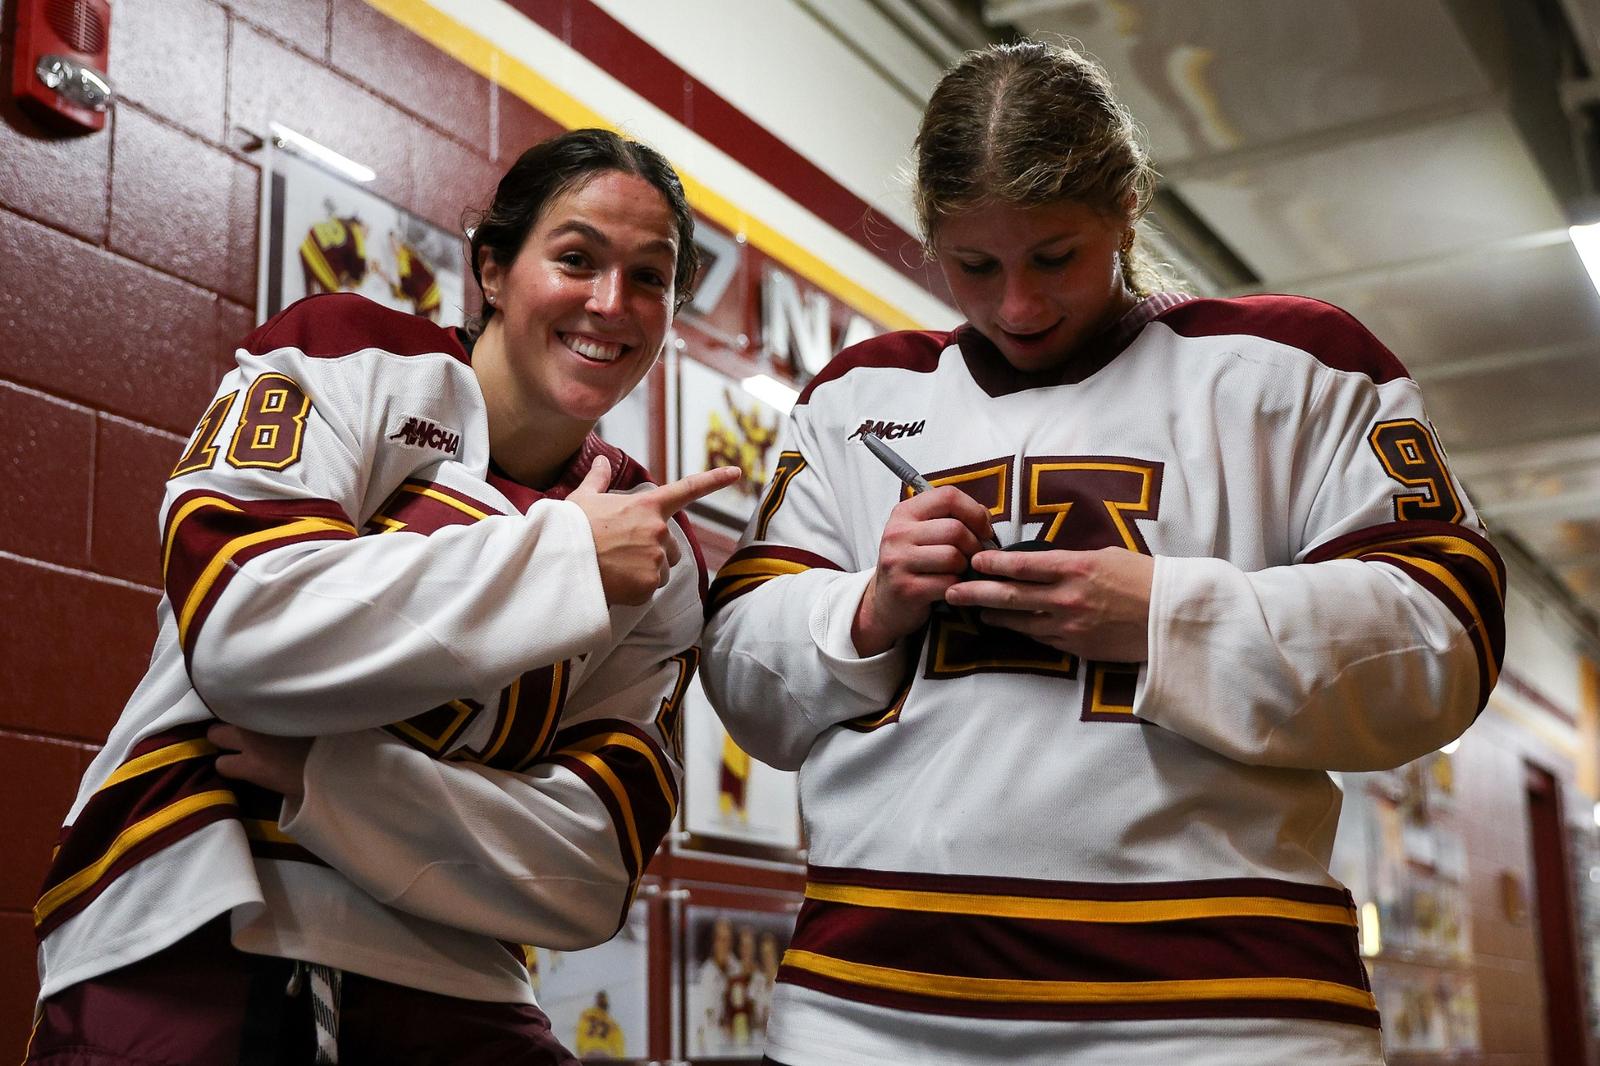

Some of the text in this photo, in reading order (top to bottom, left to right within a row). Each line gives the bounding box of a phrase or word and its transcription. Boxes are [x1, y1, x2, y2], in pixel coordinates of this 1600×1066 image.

[169, 372, 312, 479] 18
[408, 418, 460, 455] WCHA
[868, 419, 926, 440] WCHA
[1366, 417, 1470, 524] 9
